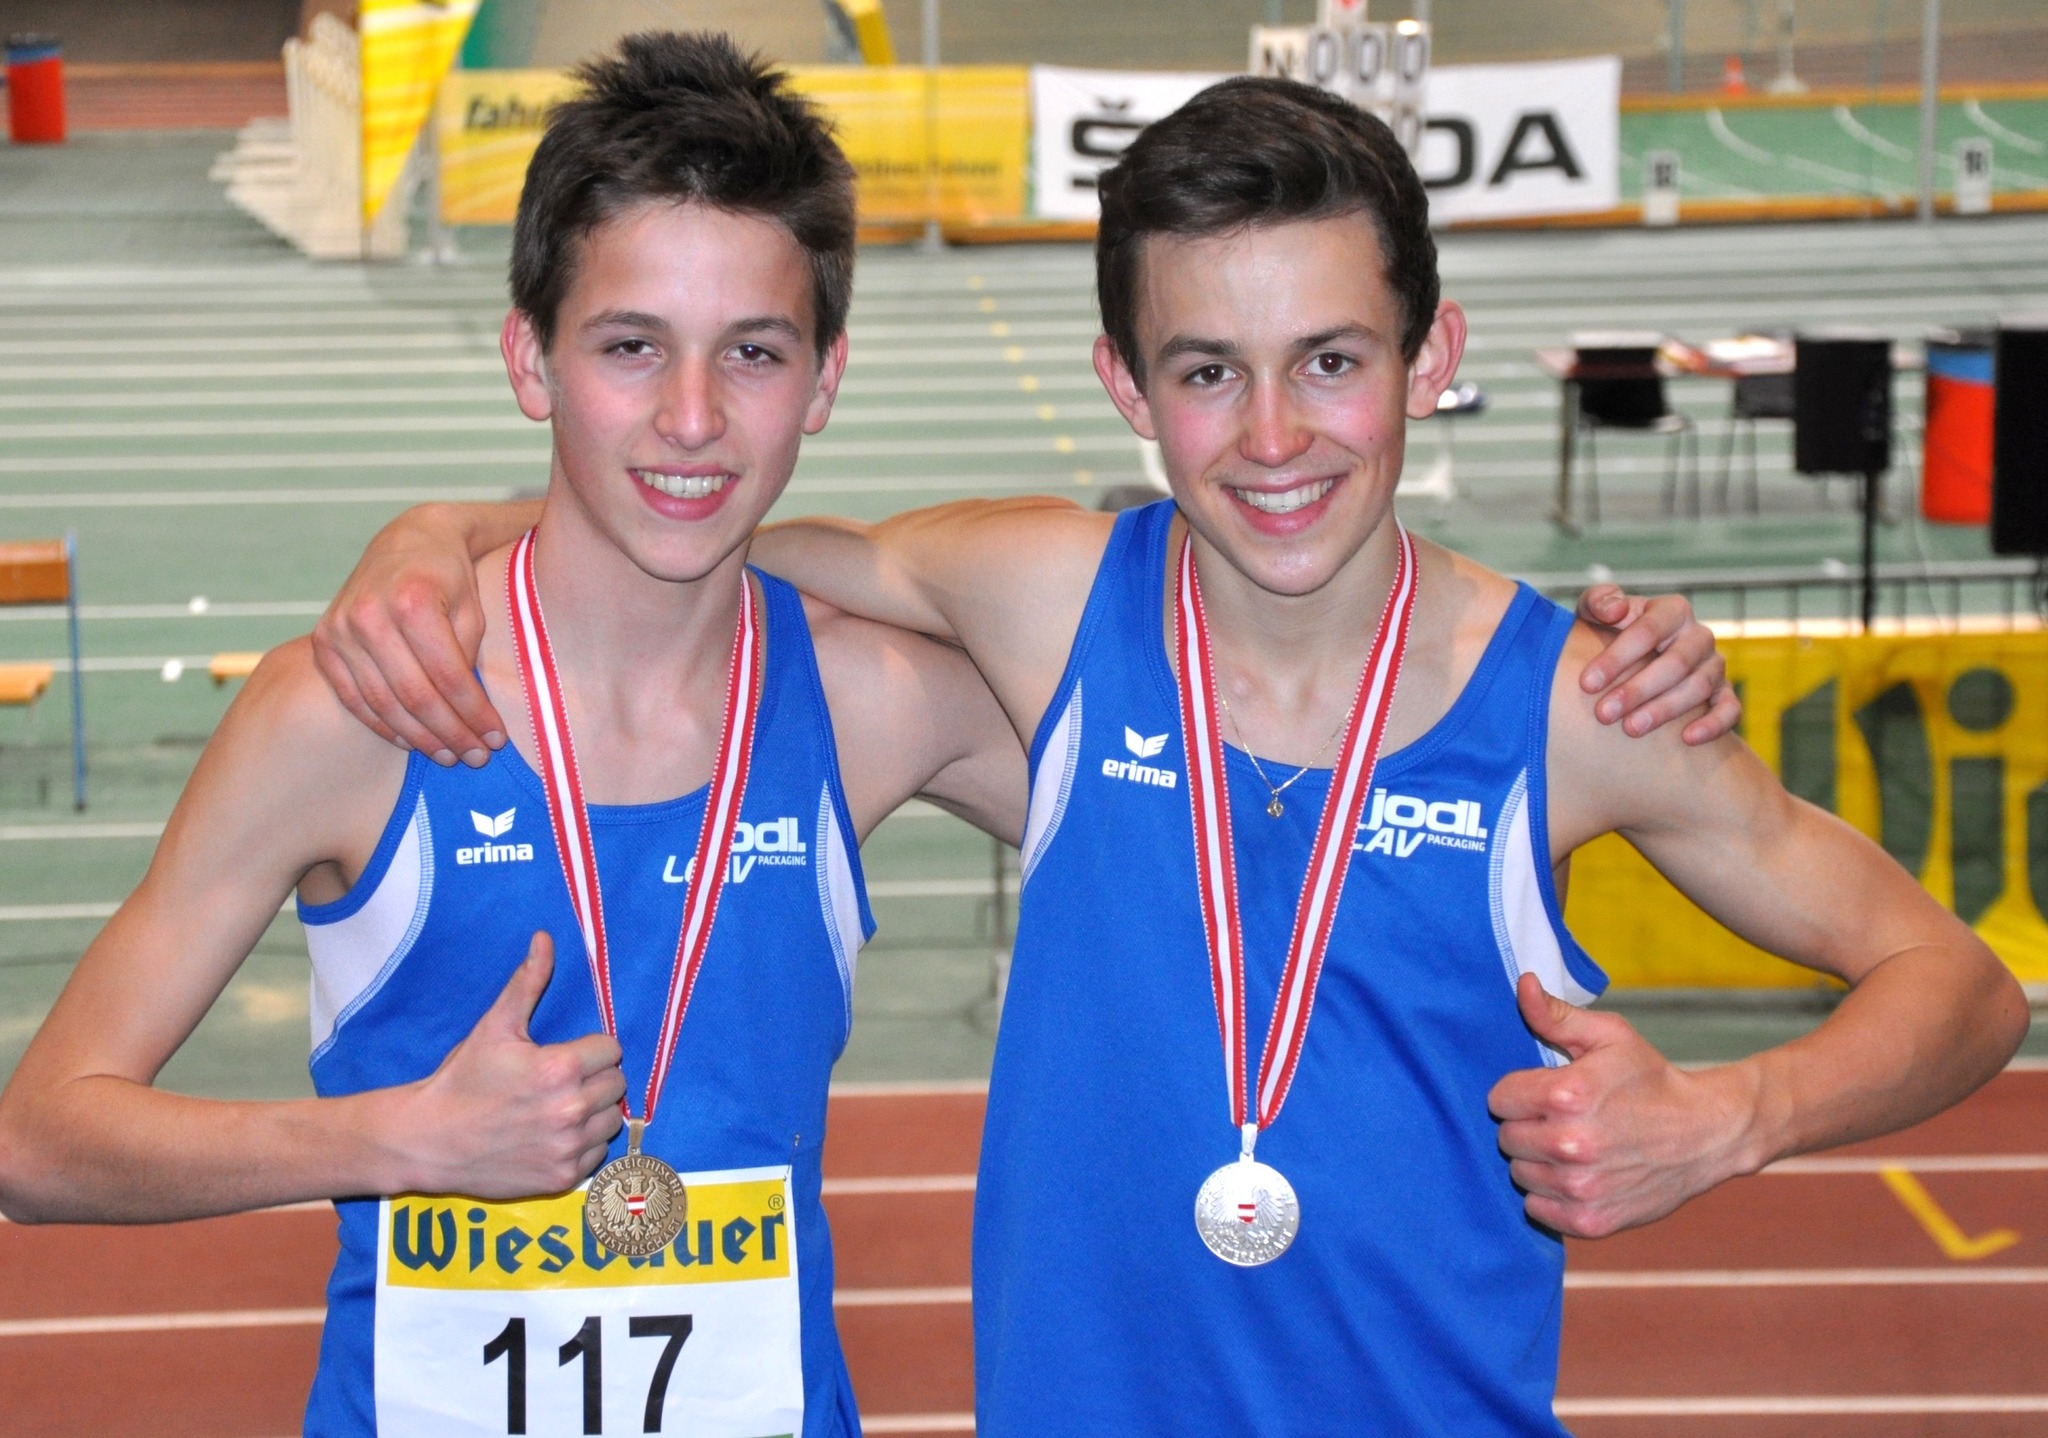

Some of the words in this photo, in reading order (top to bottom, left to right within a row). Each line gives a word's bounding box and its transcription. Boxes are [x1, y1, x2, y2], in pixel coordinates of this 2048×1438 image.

[1071, 97, 1583, 189] ŠDA
[1102, 758, 1177, 788] erima
[456, 842, 533, 865] erima
[758, 855, 806, 866] PACKAGING
[1426, 833, 1486, 852] PACKAGING
[589, 1157, 684, 1203] ÖSTERREICHISCHE
[393, 1204, 784, 1274] Wiesbuer
[591, 1218, 681, 1255] MEISTERSCHAFT
[483, 1314, 693, 1436] 117
